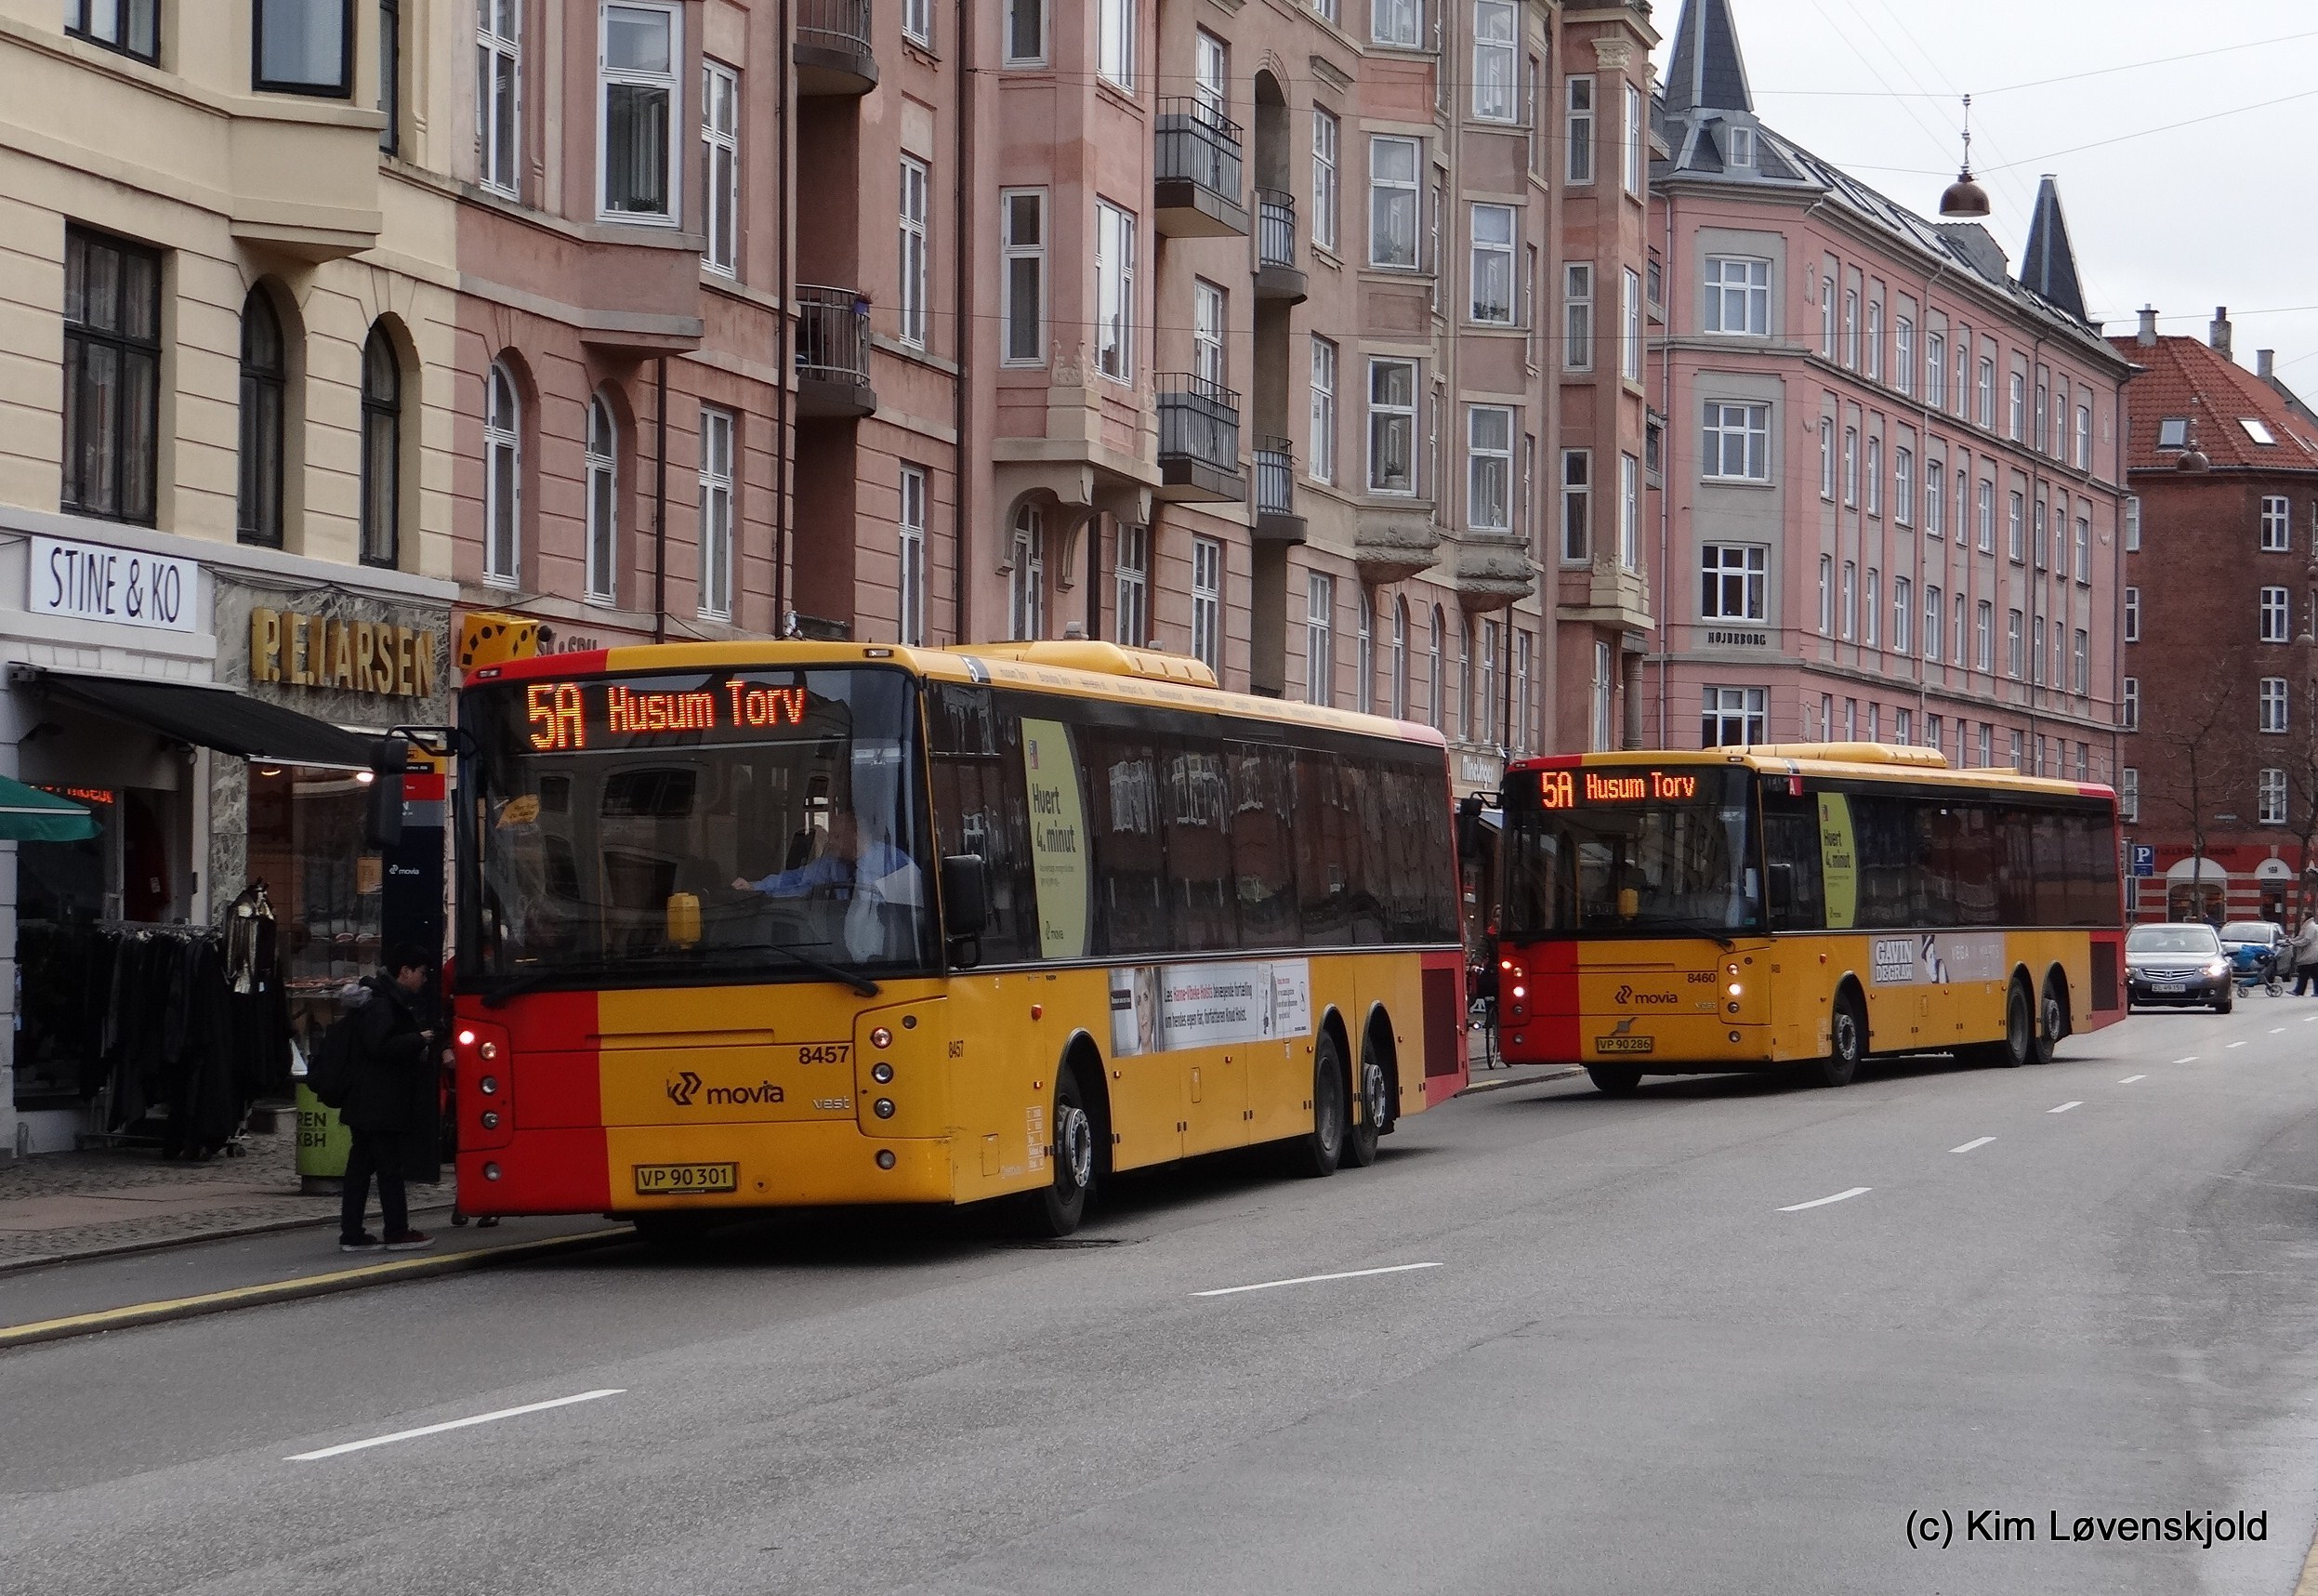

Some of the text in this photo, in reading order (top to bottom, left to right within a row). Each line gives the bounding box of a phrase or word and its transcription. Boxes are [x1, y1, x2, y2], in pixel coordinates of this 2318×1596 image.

[49, 547, 180, 623] STINE & KO
[1707, 632, 1767, 645] HØJDEBORG
[527, 679, 805, 749] 5A Husum Torv
[1541, 772, 1695, 808] 5A Husum Torv
[1047, 819, 1076, 853] minut
[1832, 849, 1851, 869] minut
[2137, 847, 2151, 863] P
[398, 867, 420, 876] movia
[1876, 940, 1913, 964] GAVIN
[1687, 972, 1716, 983] 8460
[1635, 990, 1679, 1004] movia
[948, 1039, 964, 1059] 8457
[1600, 1038, 1650, 1049] VP 90 286
[798, 1045, 849, 1065] 8457
[706, 1080, 784, 1104] movia
[812, 1095, 850, 1110] vest
[640, 1167, 728, 1187] VP 90 301
